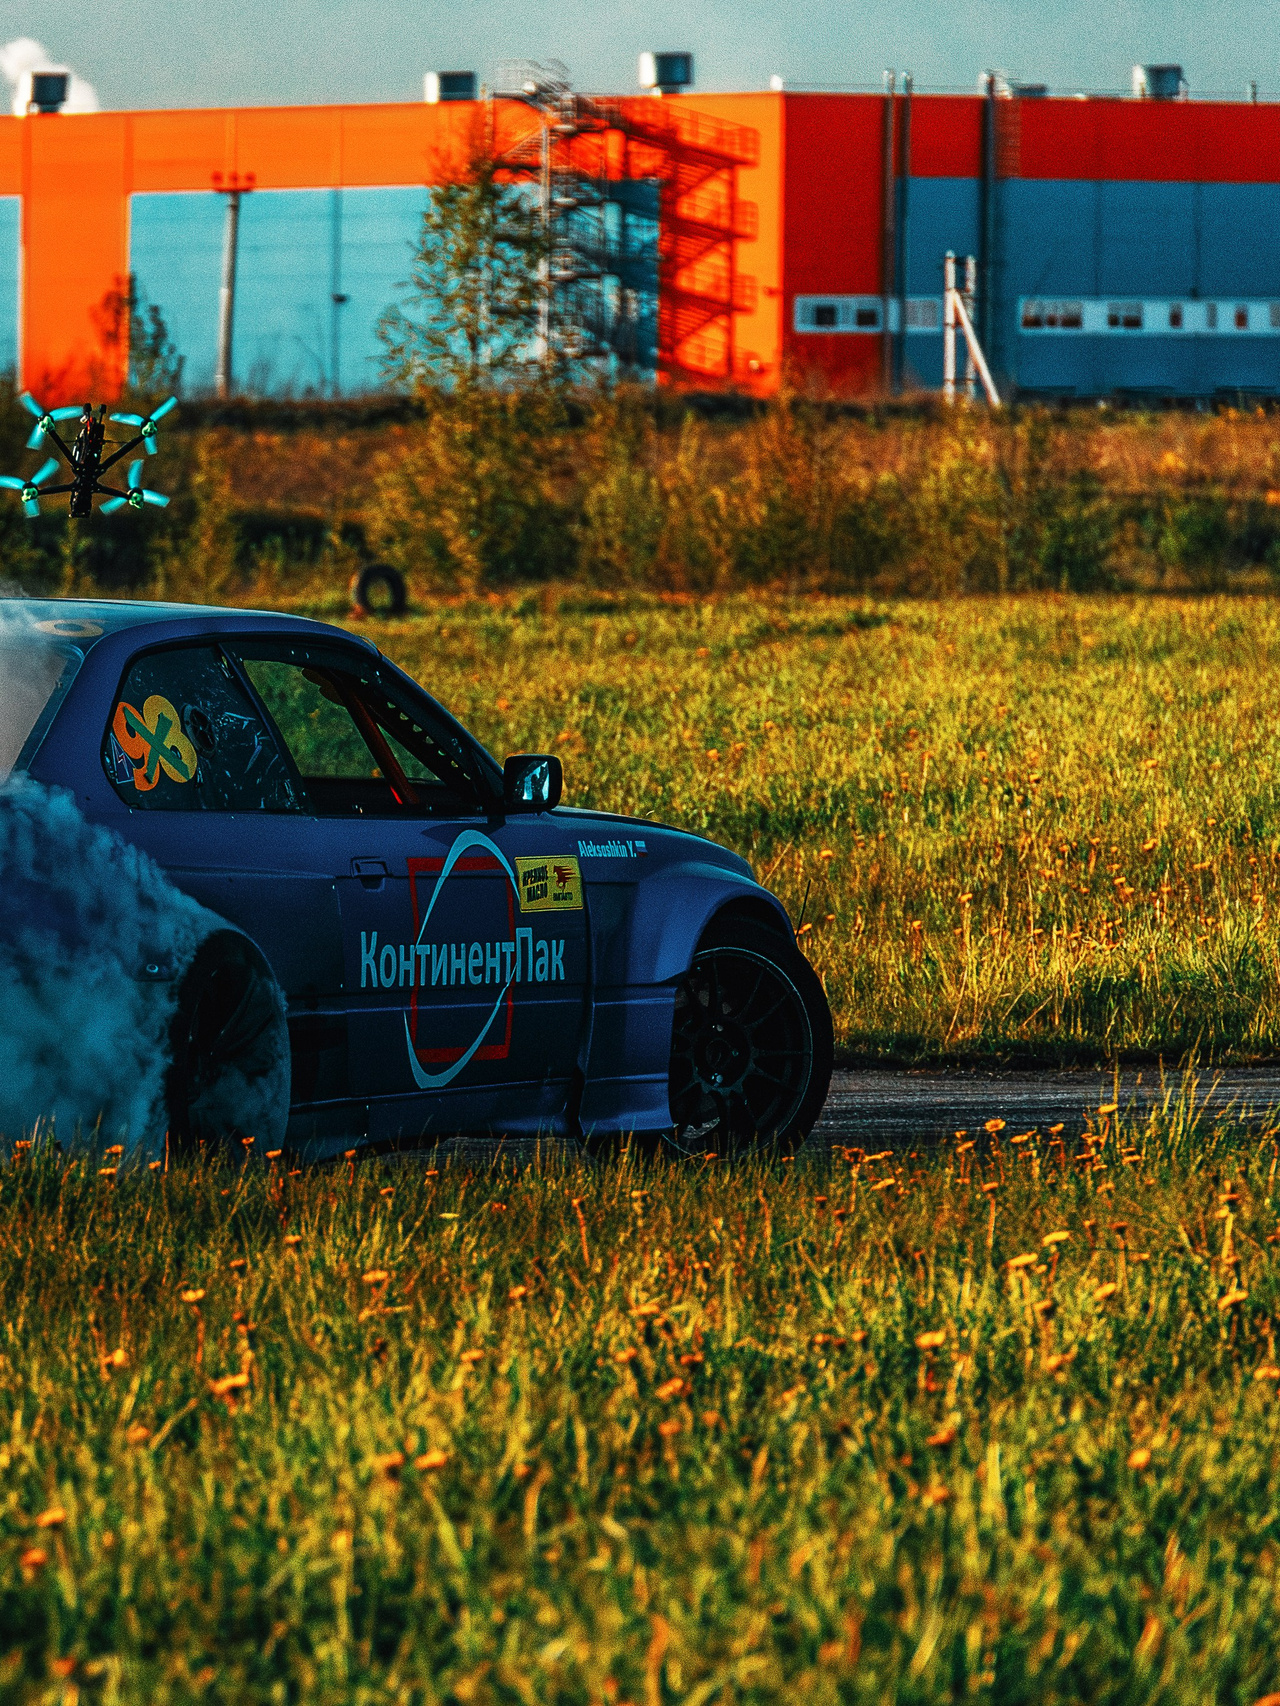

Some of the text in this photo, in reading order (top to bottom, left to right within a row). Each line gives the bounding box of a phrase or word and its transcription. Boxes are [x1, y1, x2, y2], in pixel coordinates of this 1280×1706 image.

[577, 840, 637, 858] Aleksashkin Y.
[360, 927, 565, 988] КонтинентПак
